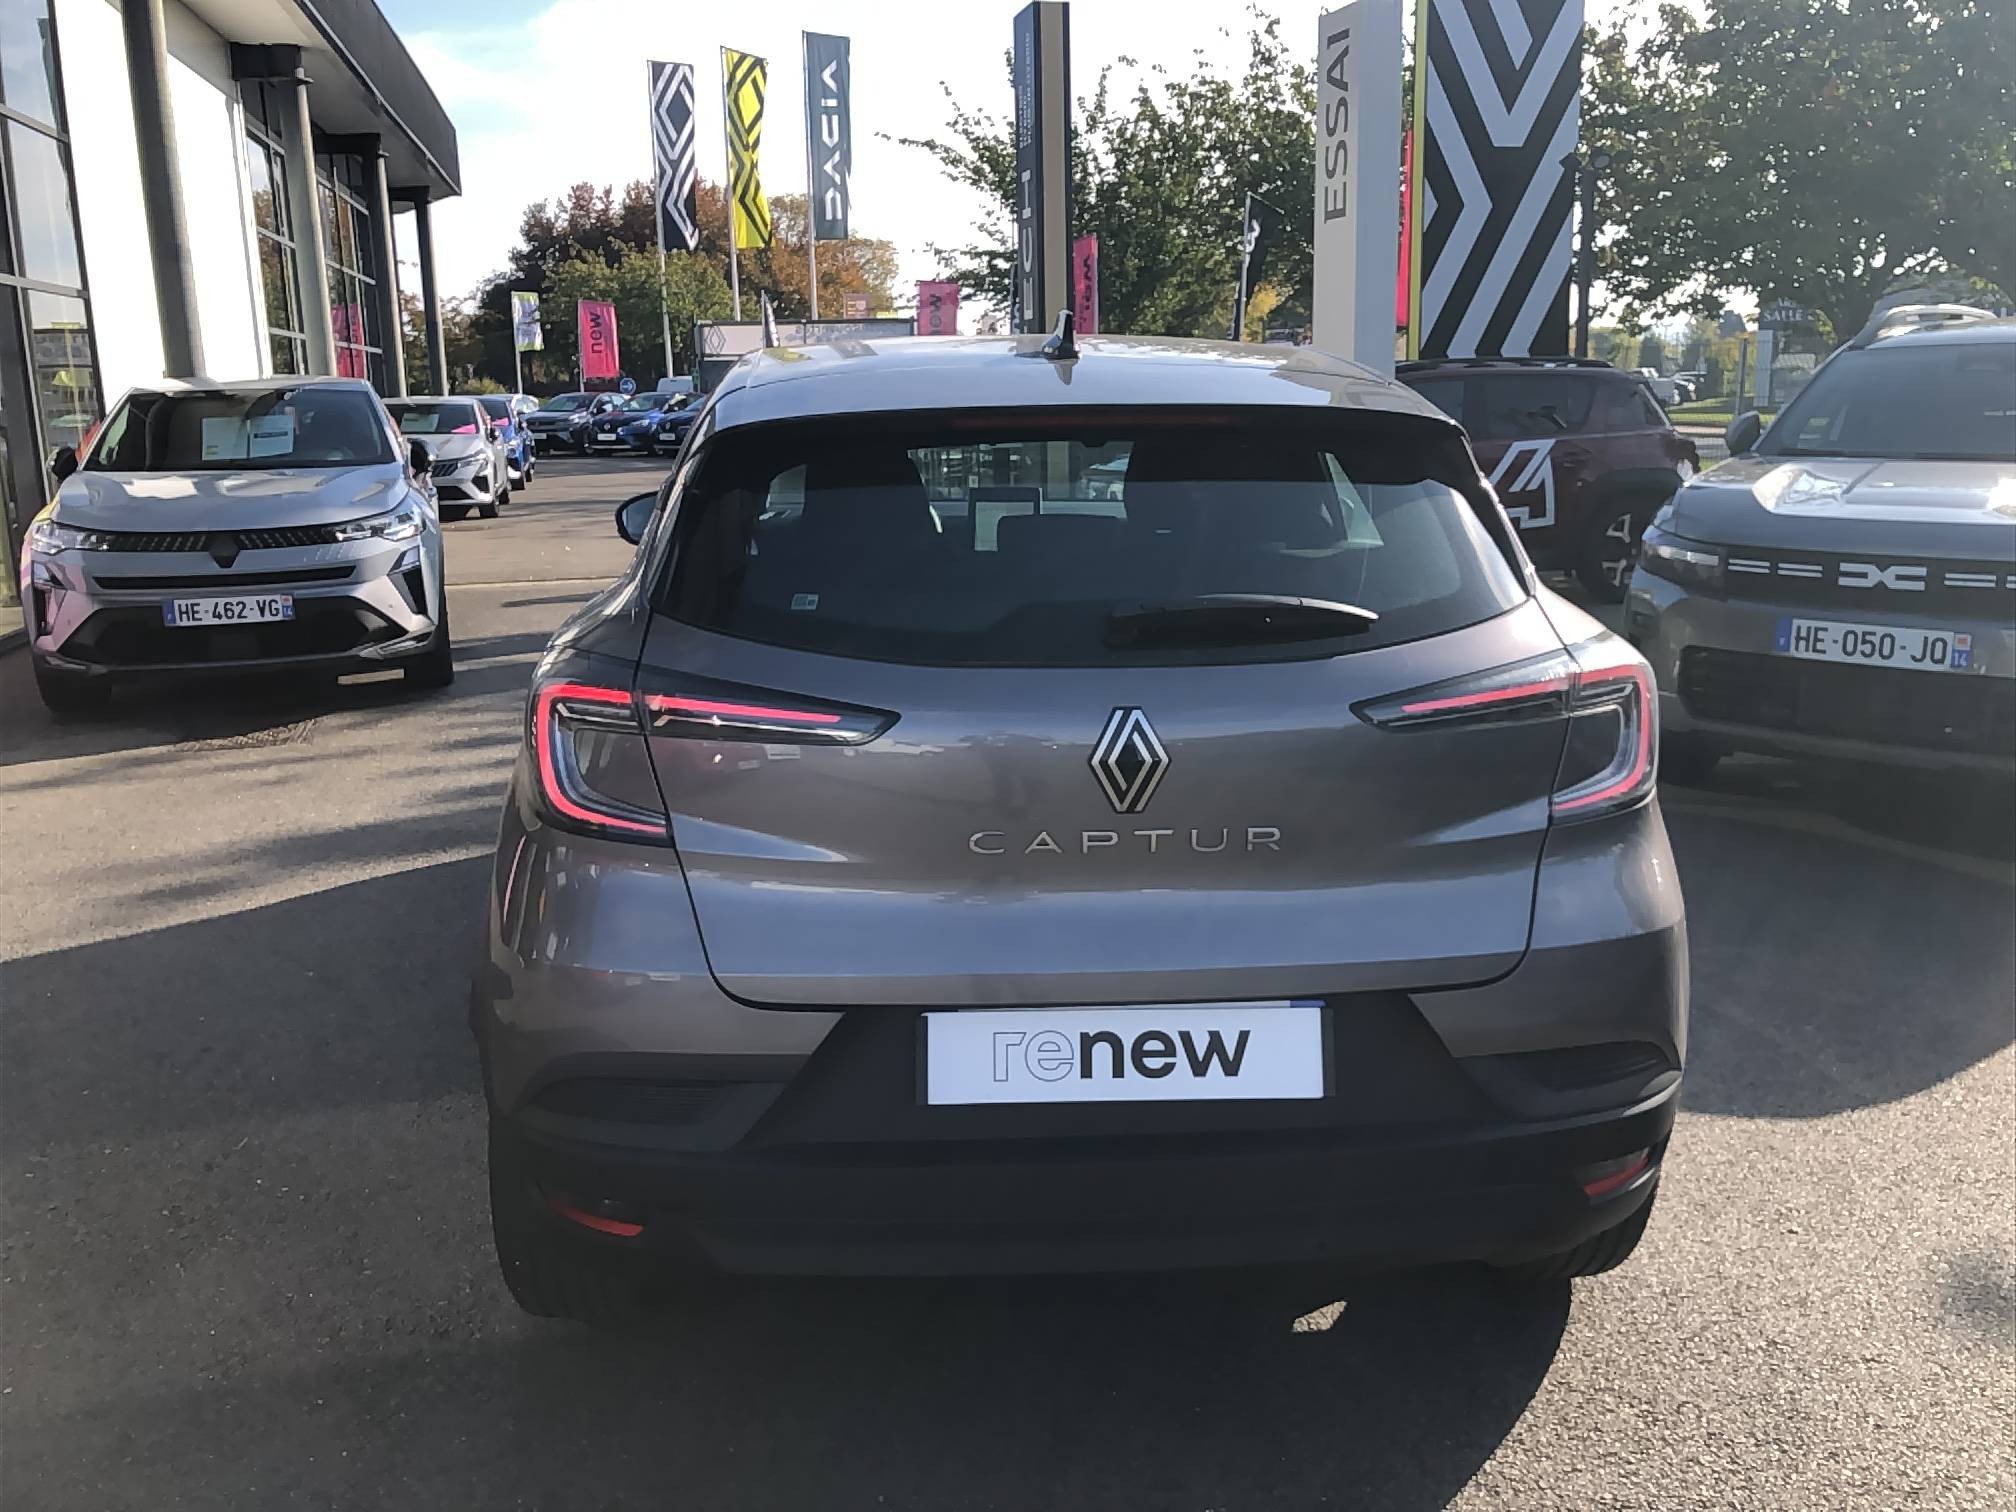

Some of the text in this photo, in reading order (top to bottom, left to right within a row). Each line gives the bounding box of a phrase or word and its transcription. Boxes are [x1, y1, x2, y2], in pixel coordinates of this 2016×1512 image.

[820, 59, 843, 221] DACIA
[1324, 26, 1351, 225] ESSAI
[1020, 169, 1034, 334] ECH
[177, 598, 280, 623] HE-462-VG
[1794, 625, 1948, 665] HE-050-JQ
[969, 827, 1281, 854] CAPTUR
[992, 1029, 1251, 1083] renew
